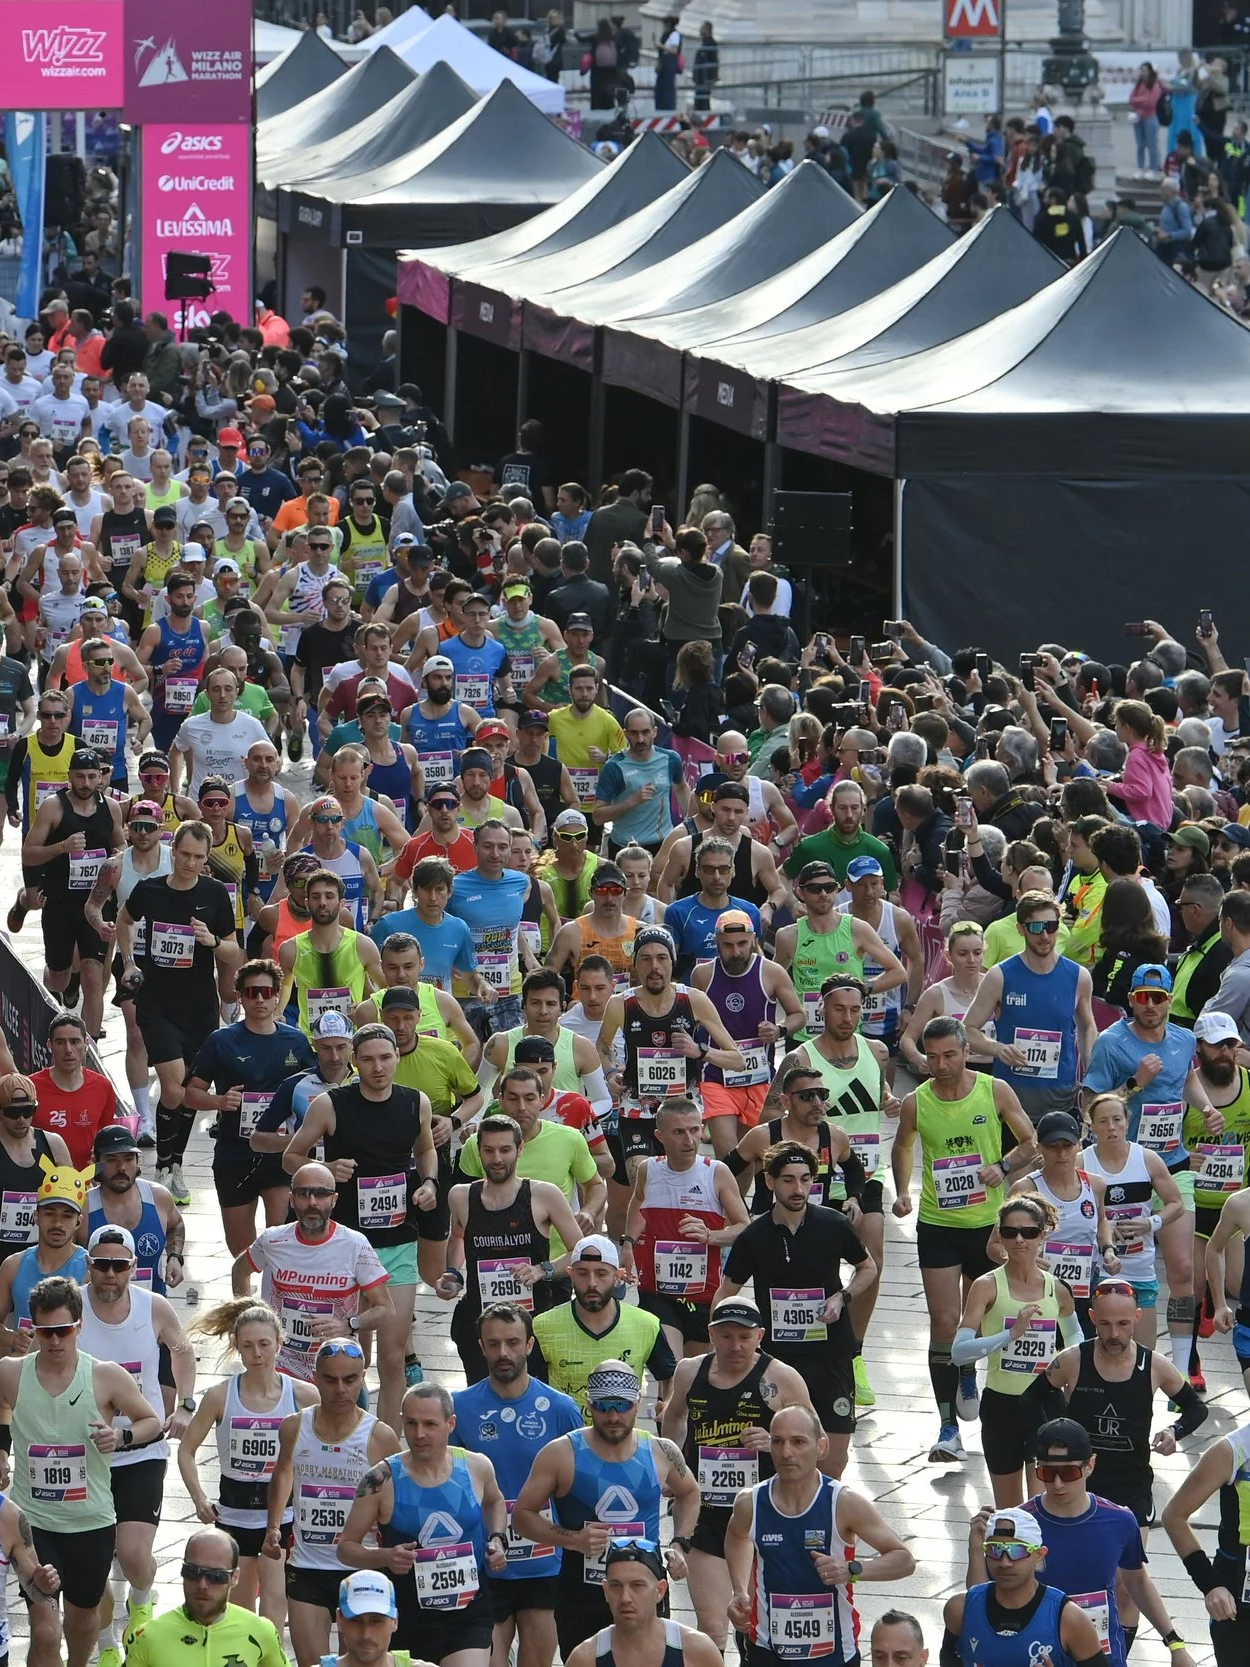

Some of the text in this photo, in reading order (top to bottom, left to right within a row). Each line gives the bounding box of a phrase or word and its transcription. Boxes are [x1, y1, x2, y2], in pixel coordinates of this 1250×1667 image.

[948, 0, 999, 28] M
[191, 51, 242, 60] WIZZ AIR
[41, 67, 106, 77] wizzair.com
[191, 61, 242, 71] MILANO
[176, 175, 235, 191] UniCredit
[156, 218, 233, 238] LEVISSIMA
[173, 692, 190, 700] 4850
[463, 687, 480, 697] 7326
[90, 734, 108, 744] 4673
[425, 767, 446, 777] 3580
[80, 865, 98, 877] 7627
[166, 941, 184, 954] 3073
[1006, 994, 1027, 1006] trail
[1027, 1048, 1046, 1062] 1174
[649, 1068, 675, 1081] 6026
[1150, 1124, 1175, 1136] 3656
[1206, 1163, 1233, 1178] 4284
[945, 1173, 975, 1192] 2028
[371, 1195, 398, 1210] 2494
[473, 1233, 531, 1248] COURIRÀLYON
[669, 1263, 692, 1278] 1142
[1054, 1264, 1082, 1280] 4229
[491, 1282, 522, 1296] 2696
[783, 1310, 814, 1324] 4305
[1014, 1340, 1046, 1357] 2929
[243, 1440, 276, 1456] 6905
[44, 1468, 71, 1483] 1819
[321, 1465, 363, 1478] MARATHON
[712, 1472, 745, 1487] 2269
[312, 1509, 345, 1527] 2536
[762, 1534, 784, 1542] AVIS
[432, 1569, 465, 1590] 2594
[785, 1620, 820, 1639] 4549
